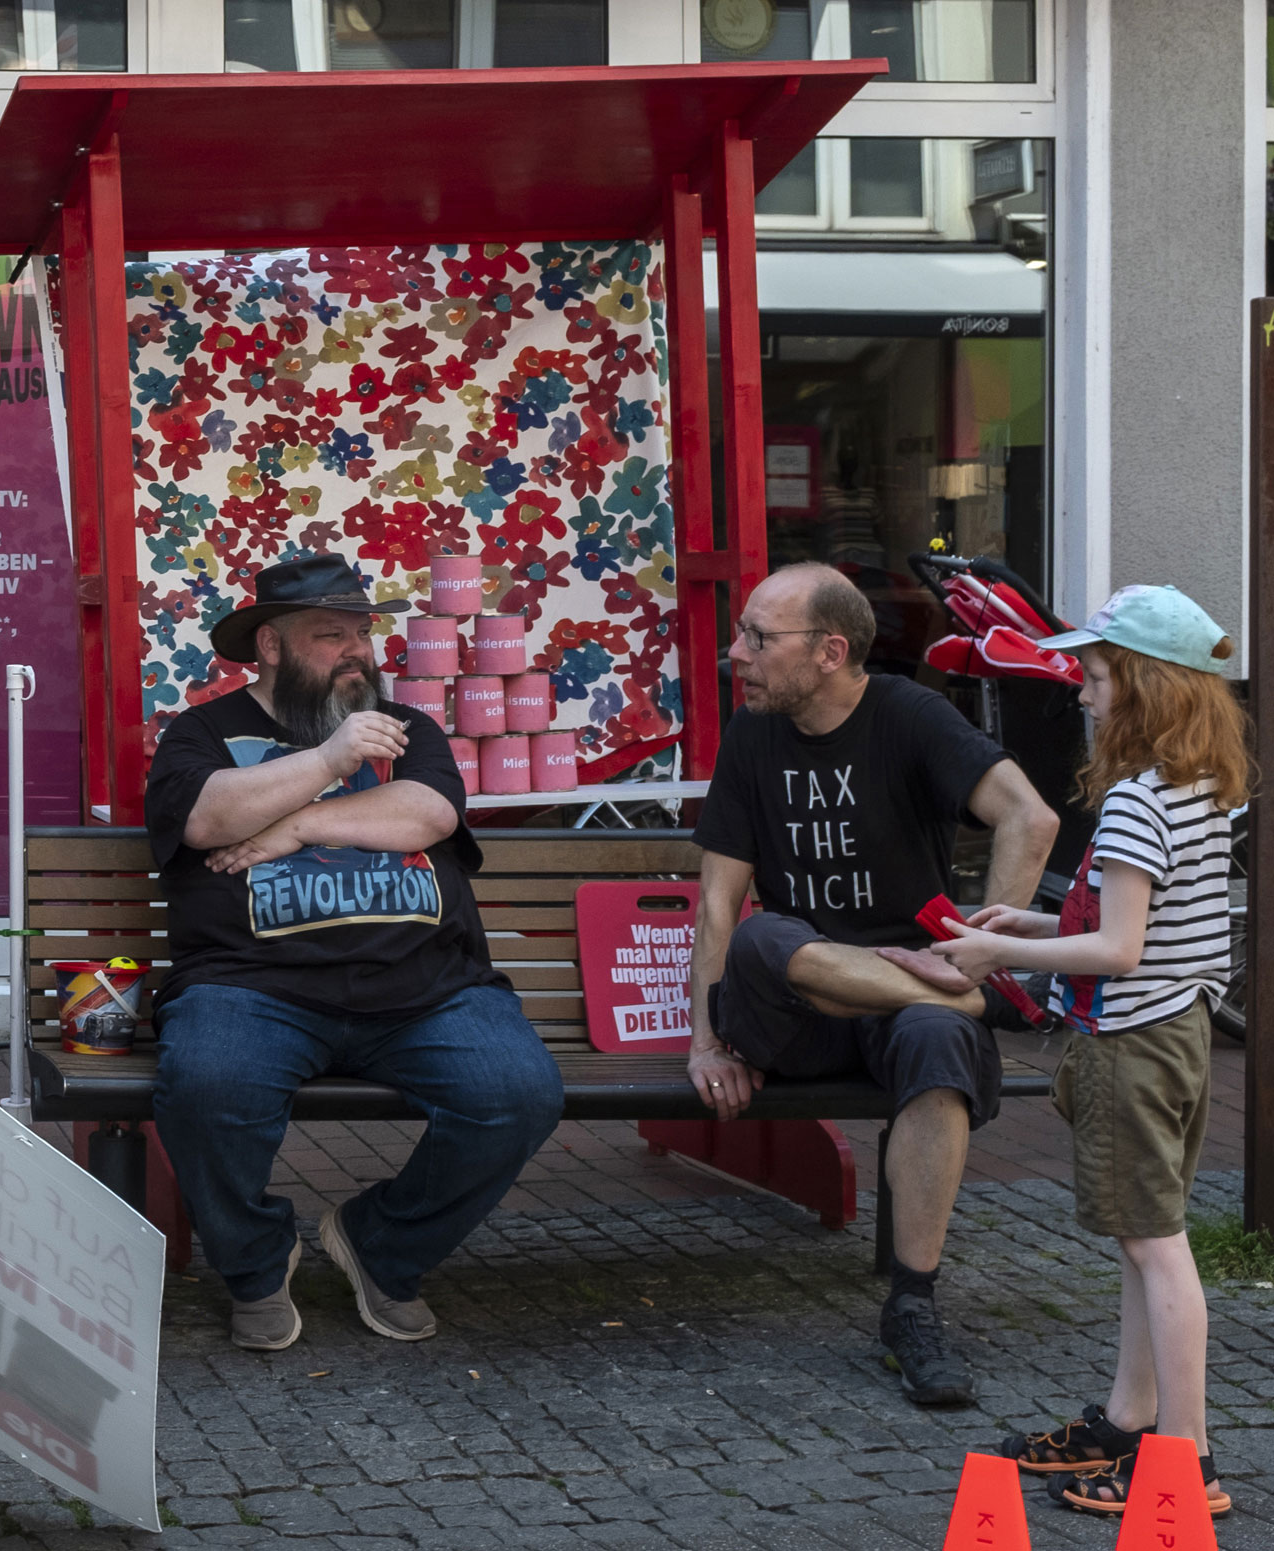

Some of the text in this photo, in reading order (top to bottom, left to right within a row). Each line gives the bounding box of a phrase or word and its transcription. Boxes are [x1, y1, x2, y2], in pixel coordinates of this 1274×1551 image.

[783, 764, 856, 810] TAX
[786, 821, 857, 859] THE
[253, 869, 437, 927] REVOLUTION
[616, 944, 652, 964] mal
[625, 1011, 657, 1033] DIE
